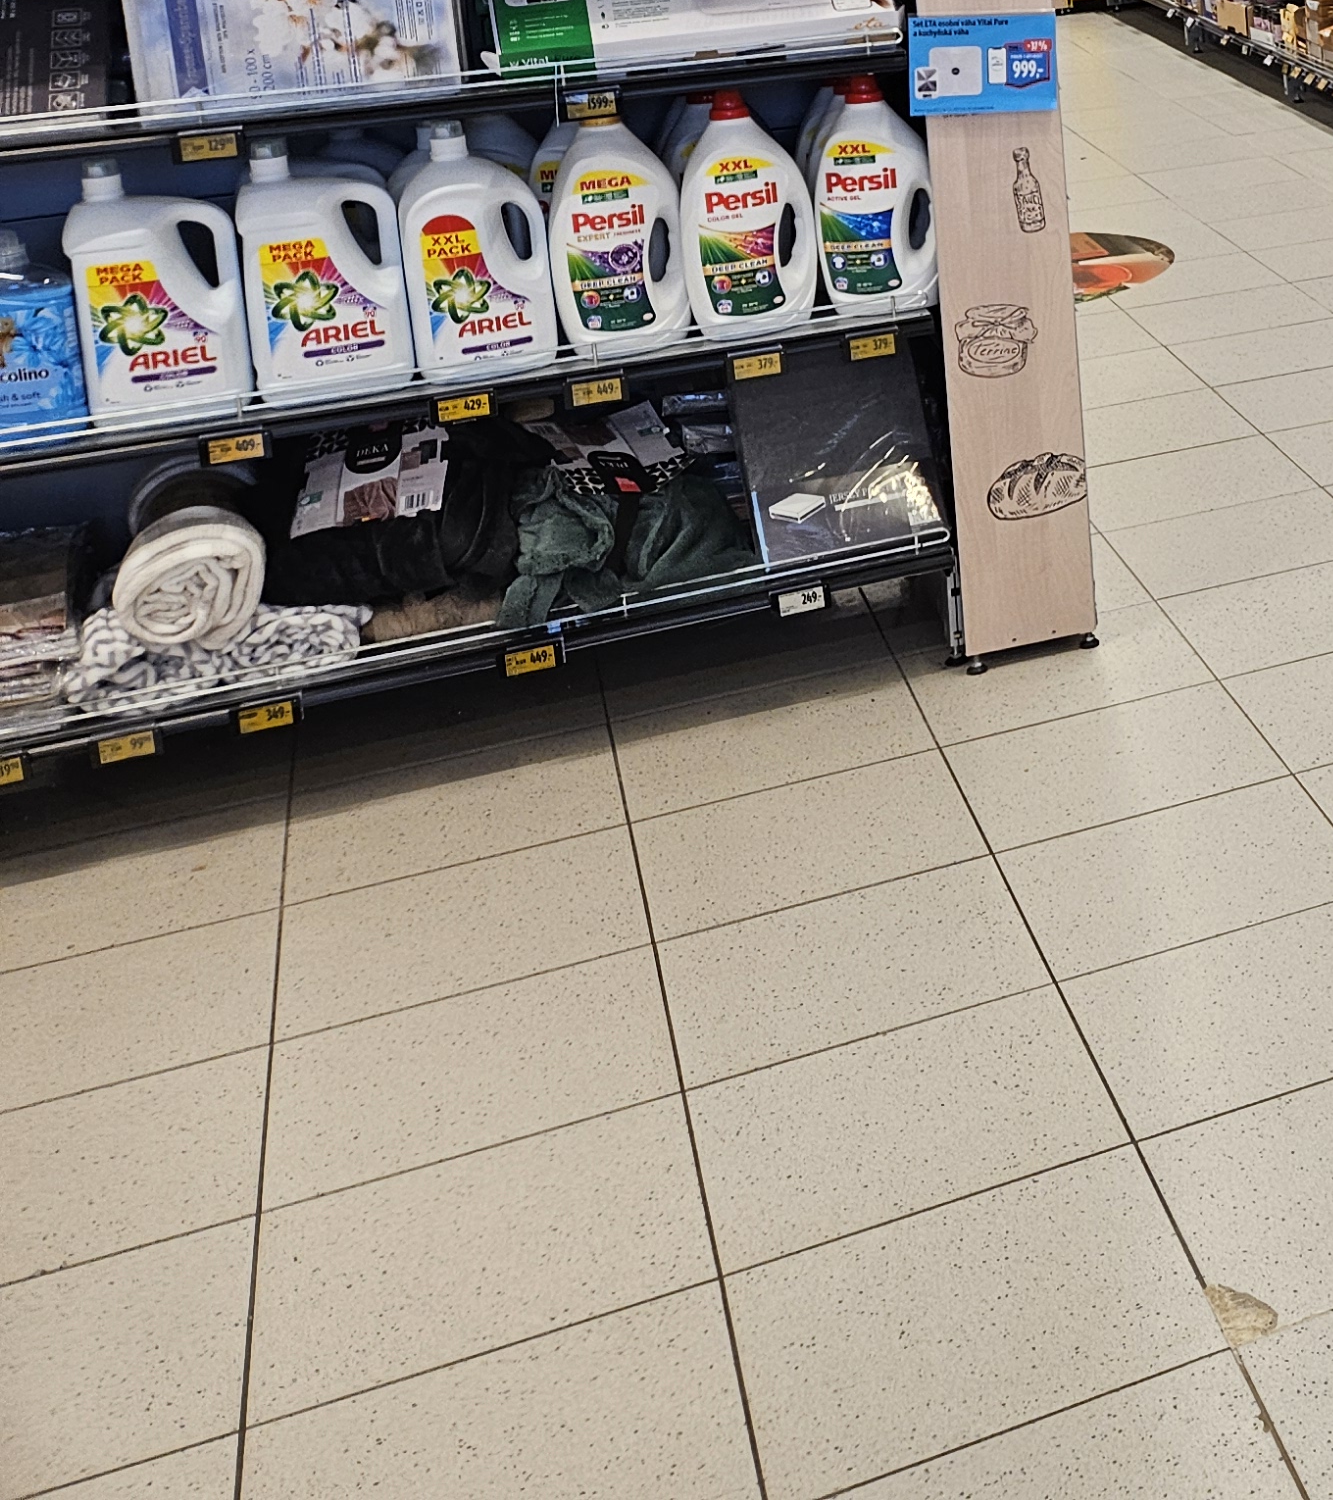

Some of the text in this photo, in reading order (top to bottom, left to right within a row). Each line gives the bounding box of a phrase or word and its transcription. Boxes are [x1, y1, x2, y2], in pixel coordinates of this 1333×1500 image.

[838, 144, 870, 156] XXL
[580, 176, 632, 191] MEGA
[826, 168, 897, 193] Persil
[705, 182, 778, 214] Persil
[572, 204, 645, 233] Persil
[431, 235, 462, 246] XXL
[427, 244, 473, 257] PACK
[95, 263, 145, 277] MEGA
[99, 272, 143, 285] PACK
[458, 311, 532, 338] ARIEL
[301, 320, 385, 347] ARIEL
[973, 341, 1020, 358] Terrine
[129, 345, 217, 372] ARIEL
